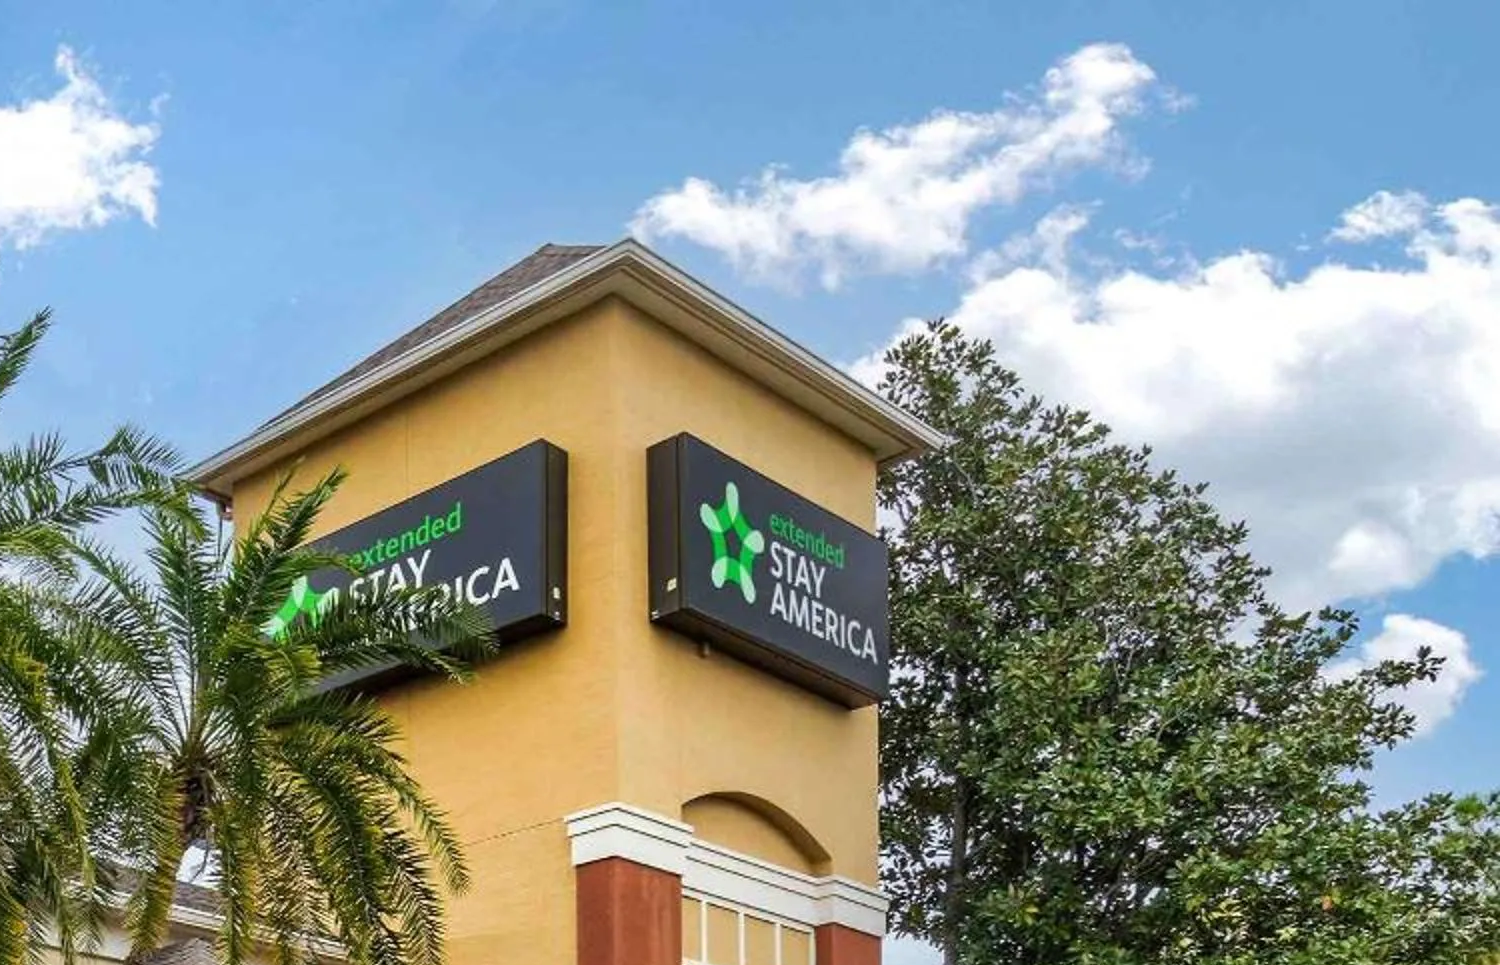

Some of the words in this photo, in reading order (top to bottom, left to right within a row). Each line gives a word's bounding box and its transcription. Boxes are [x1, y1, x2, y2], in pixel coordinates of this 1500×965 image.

[349, 501, 462, 569] extended
[769, 513, 846, 569] extended
[770, 541, 826, 599] STAY
[769, 582, 879, 665] AMERICA
